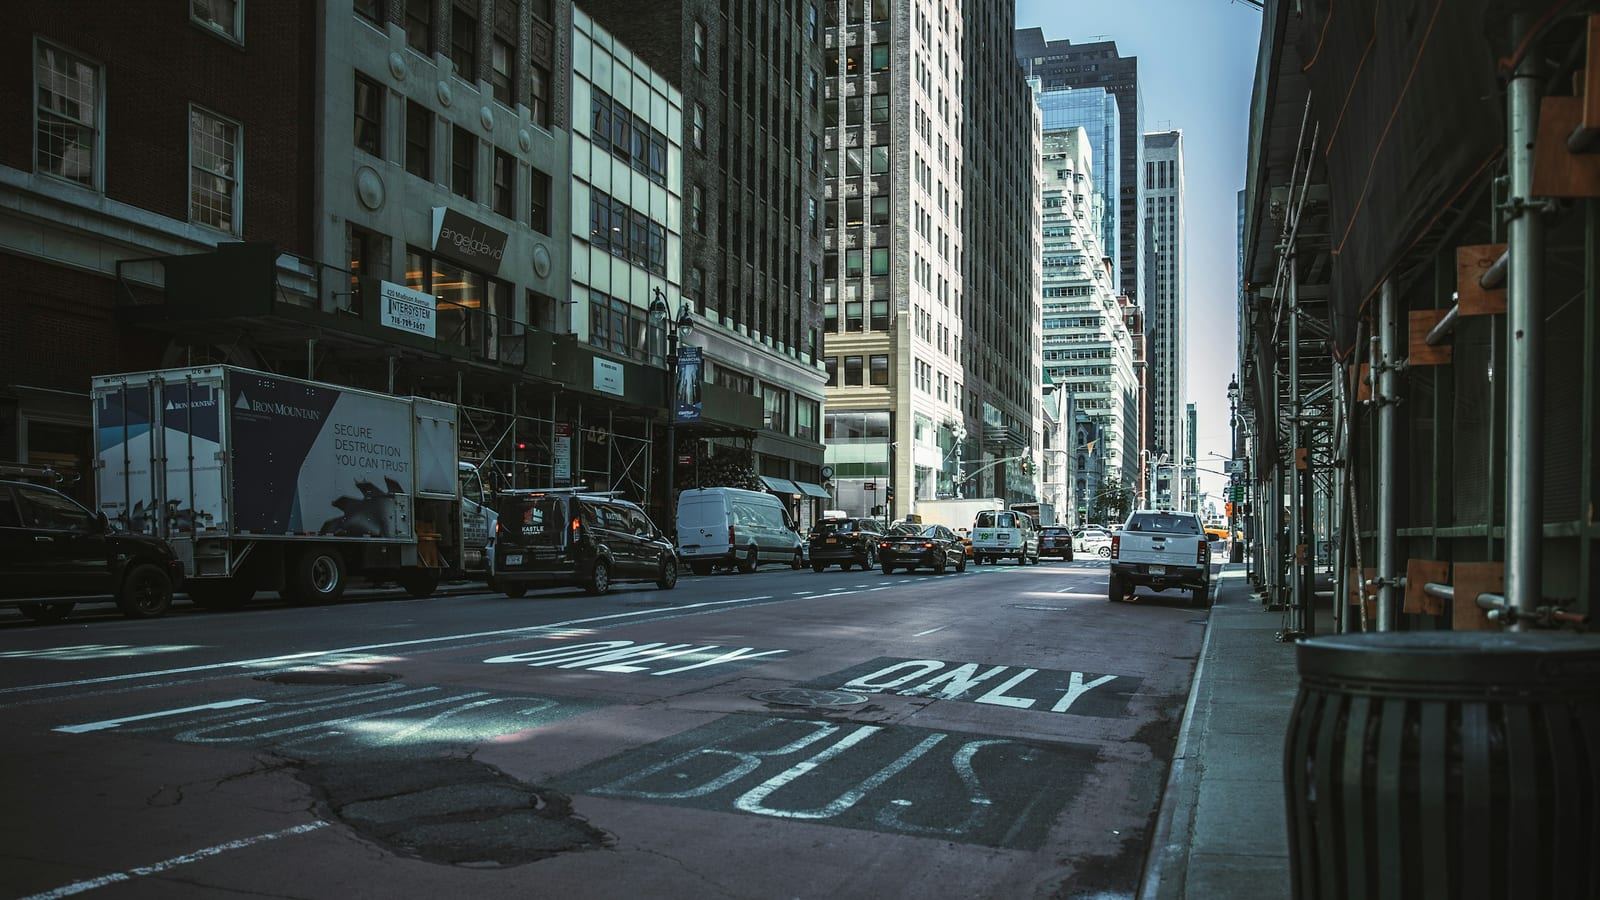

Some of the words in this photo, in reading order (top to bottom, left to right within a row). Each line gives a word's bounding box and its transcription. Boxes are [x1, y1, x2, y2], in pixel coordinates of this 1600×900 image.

[388, 299, 431, 320] INTERSYSTEM
[252, 400, 275, 414] IRON
[275, 404, 321, 420] MOUNTAIN
[334, 424, 373, 439] SECURE
[335, 439, 401, 457] DESTRUCTION
[336, 454, 357, 467] YOU
[358, 457, 379, 469] CAN
[380, 460, 409, 473] TRUST
[482, 640, 790, 676] ONLY
[836, 659, 1119, 713] ONLY
[590, 717, 1034, 834] BUS
